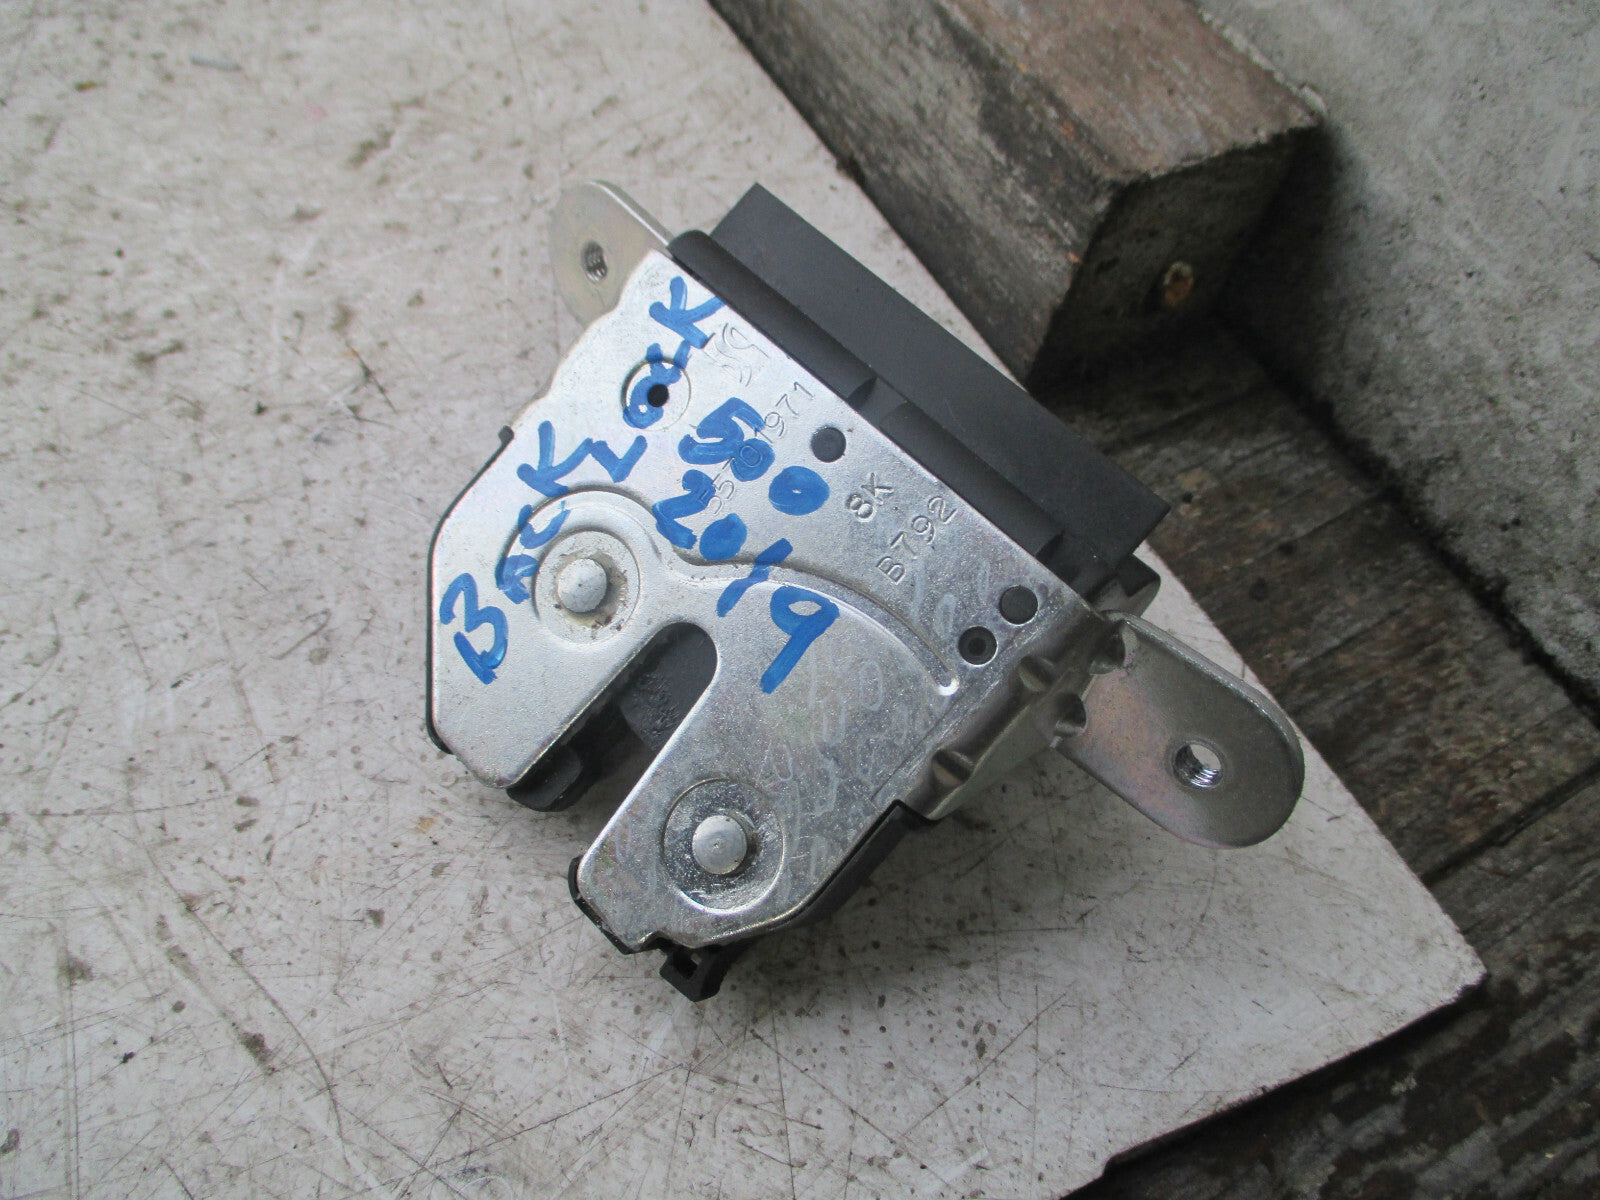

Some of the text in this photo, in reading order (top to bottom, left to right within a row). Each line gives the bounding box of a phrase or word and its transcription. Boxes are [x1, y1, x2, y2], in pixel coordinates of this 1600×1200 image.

[678, 397, 830, 517] 500
[845, 472, 894, 523] 8K
[652, 469, 840, 694] 2019
[876, 496, 958, 586] B792
